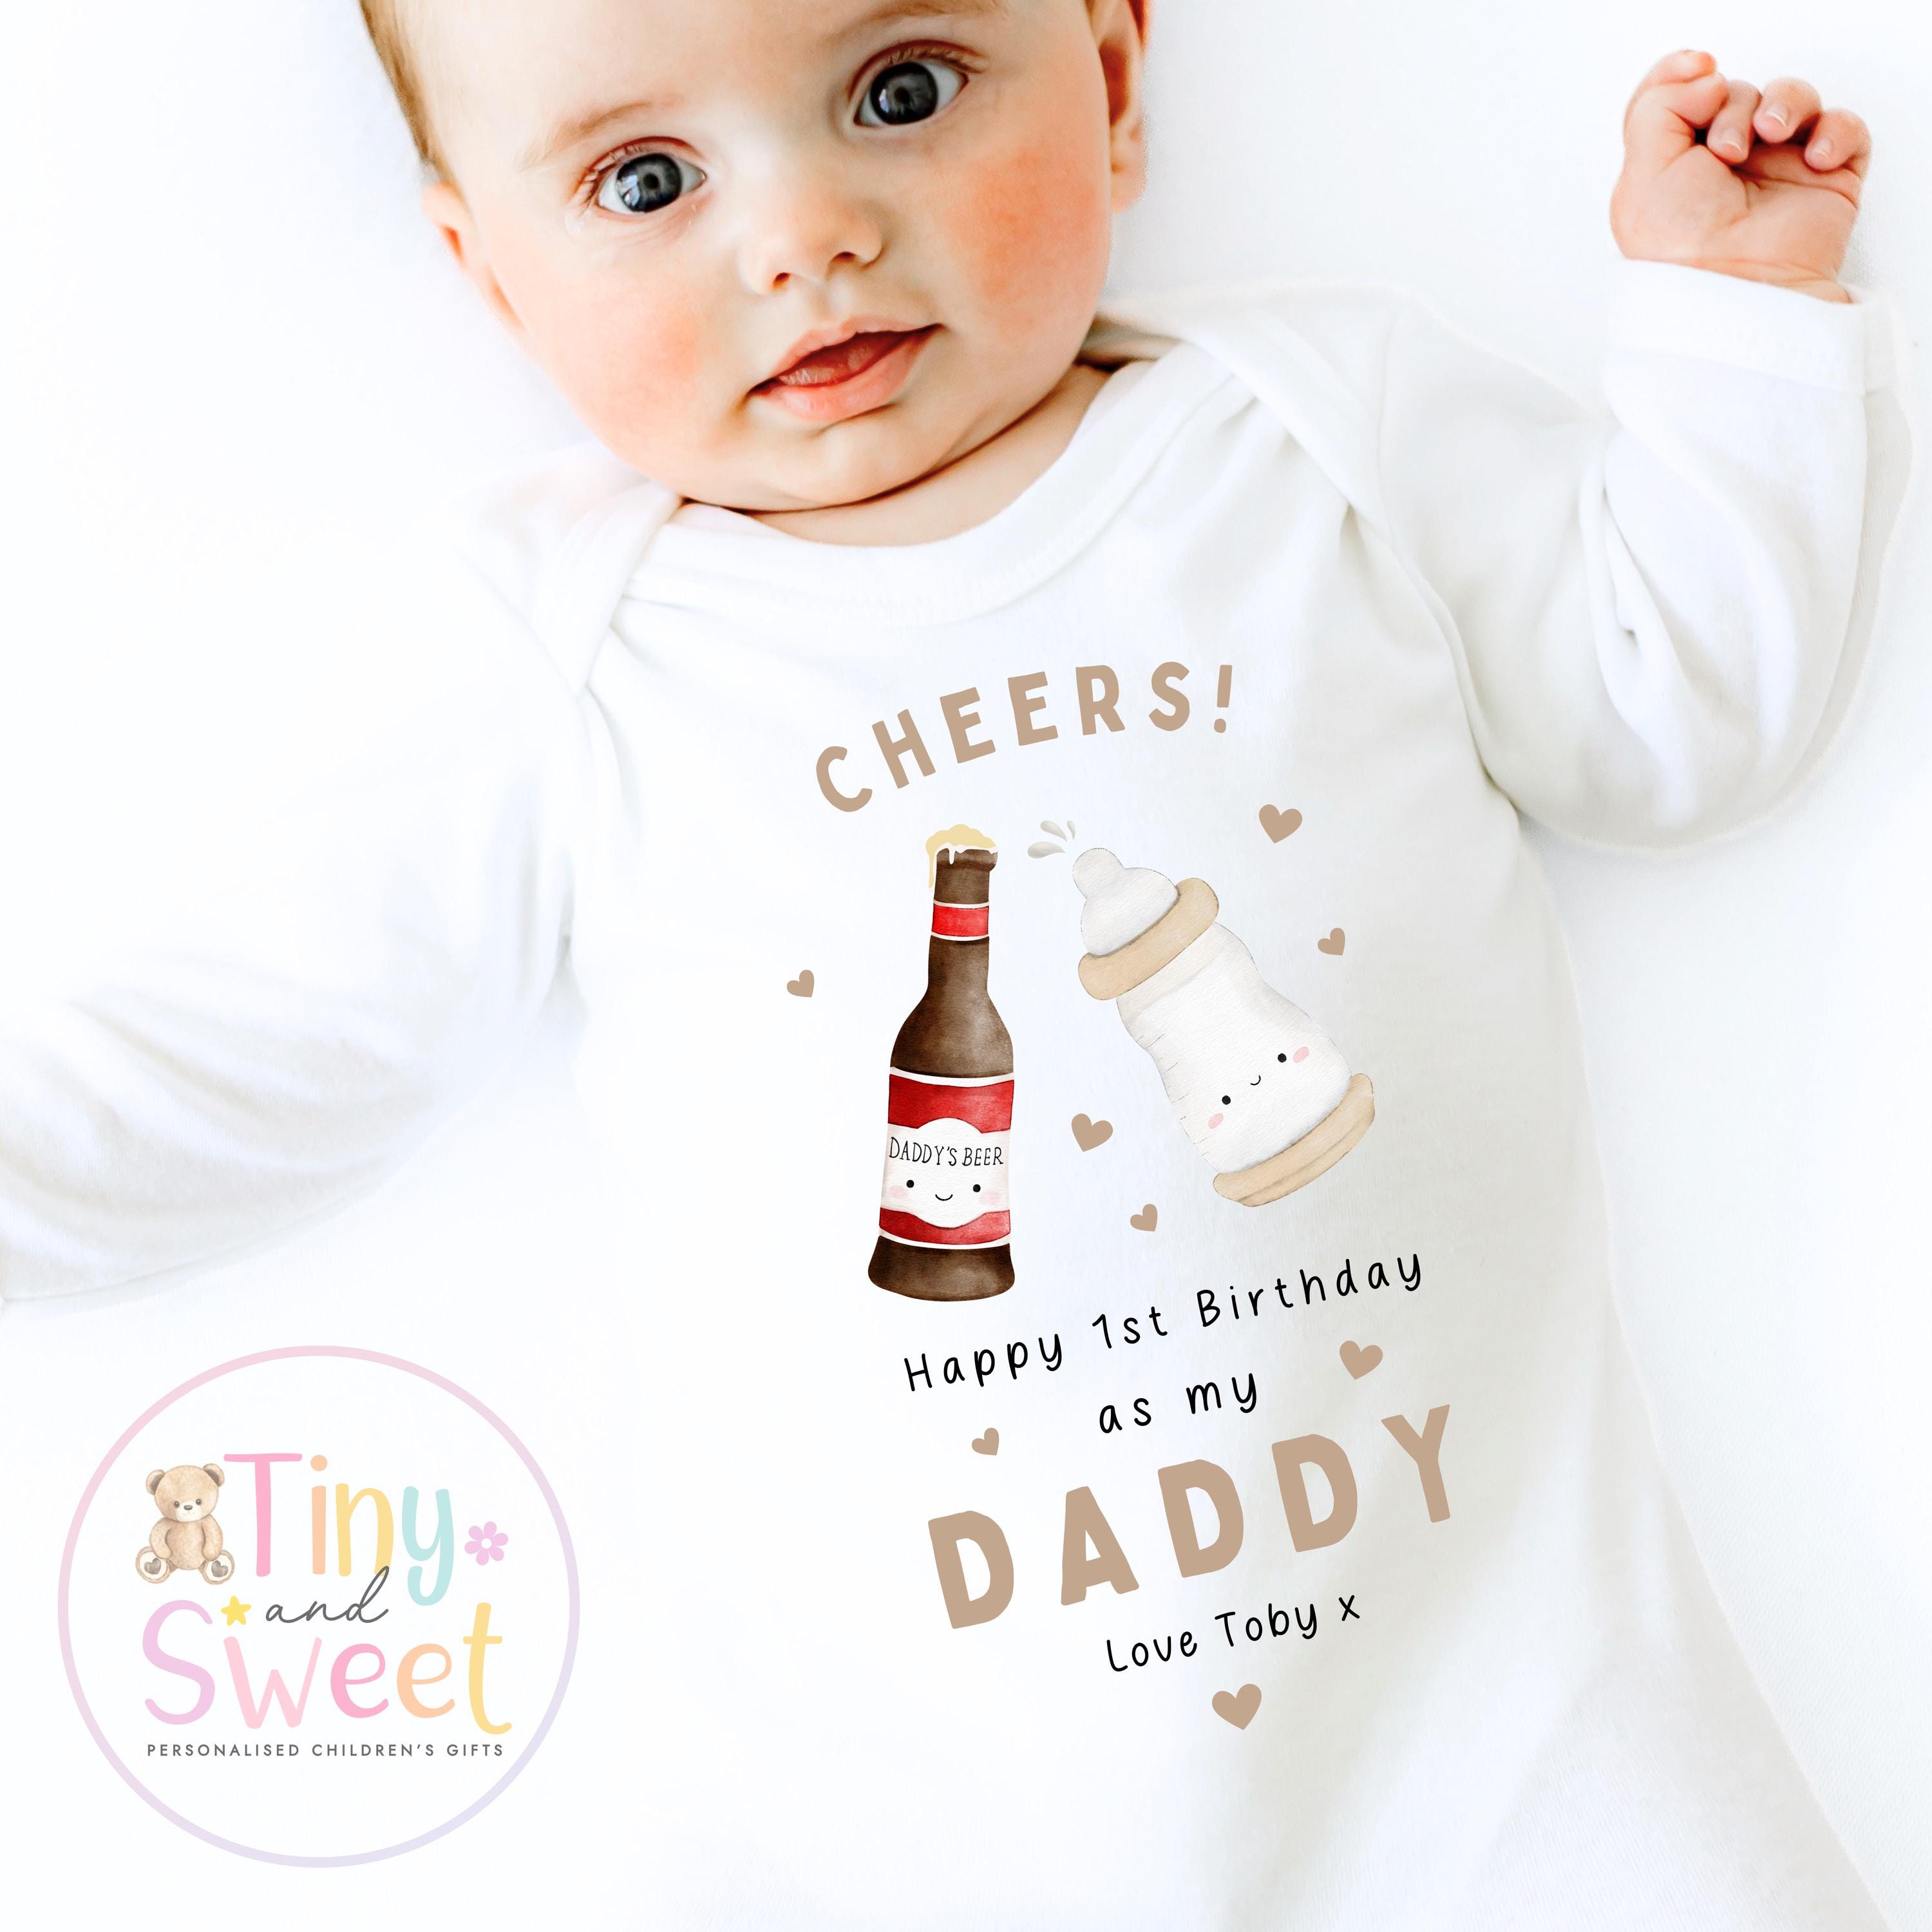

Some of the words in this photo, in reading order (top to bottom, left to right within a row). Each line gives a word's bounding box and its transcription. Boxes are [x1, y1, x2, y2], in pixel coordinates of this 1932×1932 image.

[815, 661, 1233, 813] CHEERS!
[889, 1136, 957, 1166] DADDY'S
[962, 1146, 1003, 1166] BEER
[904, 1333, 1063, 1392] Happy
[1092, 1306, 1168, 1349] 1st
[1196, 1253, 1423, 1328] Birthday
[1099, 1397, 1152, 1434] as
[1185, 1372, 1257, 1415] my
[927, 1404, 1452, 1629] DADDY
[1106, 1631, 1198, 1672] Love
[1214, 1602, 1318, 1647] Toby
[1338, 1593, 1361, 1624] x
